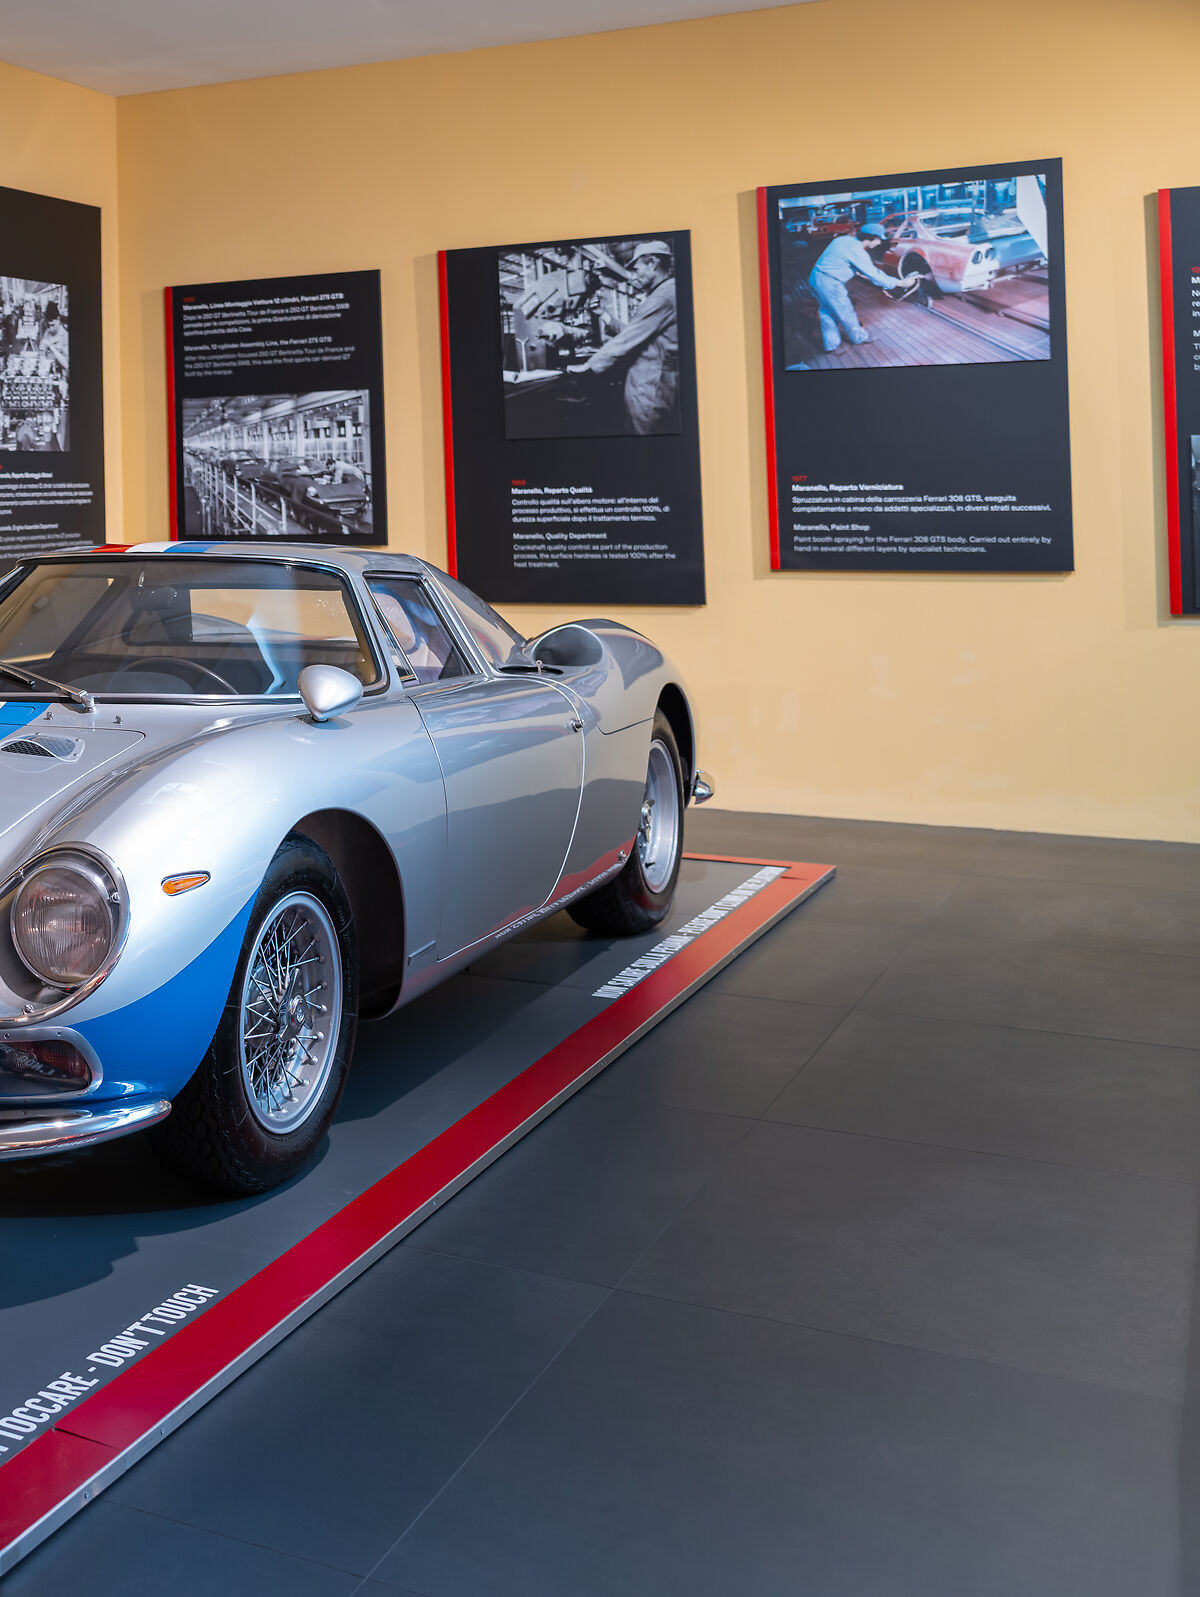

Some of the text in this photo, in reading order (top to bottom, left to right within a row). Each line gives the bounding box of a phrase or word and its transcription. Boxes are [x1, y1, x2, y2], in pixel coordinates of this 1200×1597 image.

[791, 484, 829, 492] Maranello,
[828, 483, 858, 492] Reparto
[86, 1322, 166, 1368] DON'T
[140, 1283, 220, 1325] TOUCH
